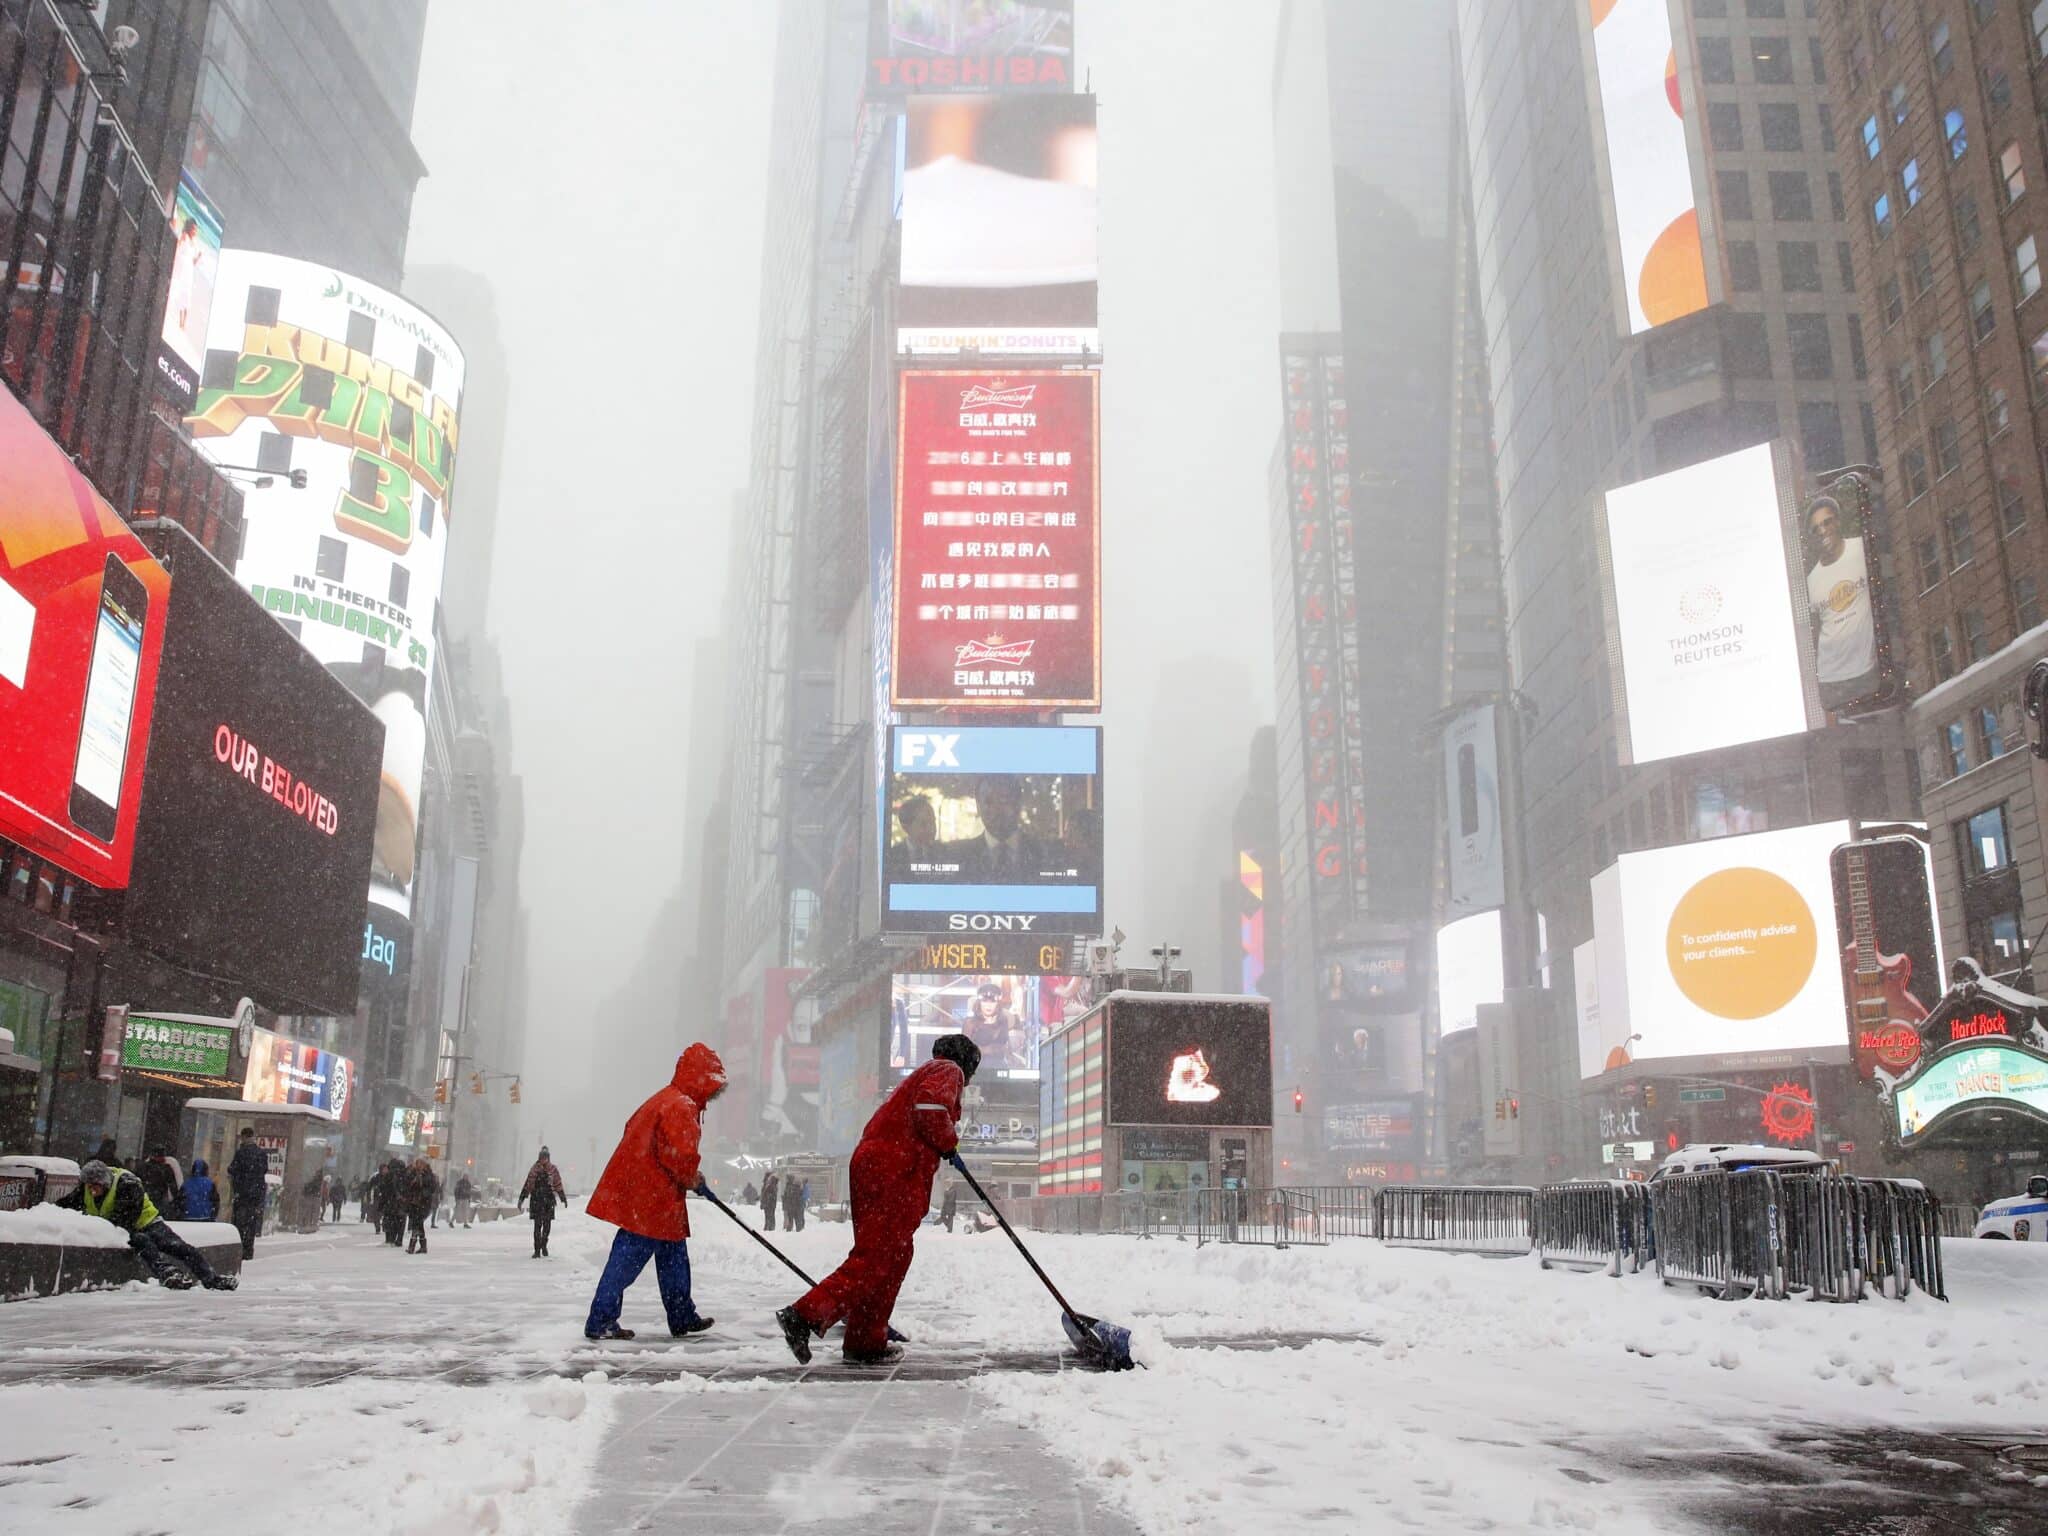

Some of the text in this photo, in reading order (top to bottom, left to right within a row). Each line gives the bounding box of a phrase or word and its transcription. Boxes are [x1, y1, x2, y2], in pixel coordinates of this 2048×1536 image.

[872, 56, 1067, 85] TOSHIBA
[1005, 335, 1077, 348] DONUTS
[157, 354, 191, 396] es.com
[242, 319, 425, 411] KUNG
[960, 389, 1034, 403] Budweiser
[333, 447, 414, 557] 3
[293, 574, 412, 630] IN THEATERS
[1668, 623, 1744, 650] THOMSON
[955, 644, 1032, 660] Budweiser
[1674, 641, 1743, 666] REUTERS
[901, 734, 961, 767] FX
[214, 724, 338, 836] OUR BELOVED
[949, 913, 1037, 931] SONY
[1682, 923, 1797, 945] To confidently advise
[1683, 949, 1706, 963] your
[125, 1022, 231, 1050] STARBUCKS
[1952, 1010, 2007, 1040] Hard Rock
[1860, 1031, 1895, 1049] Hard
[139, 1043, 206, 1065] COFFEE
